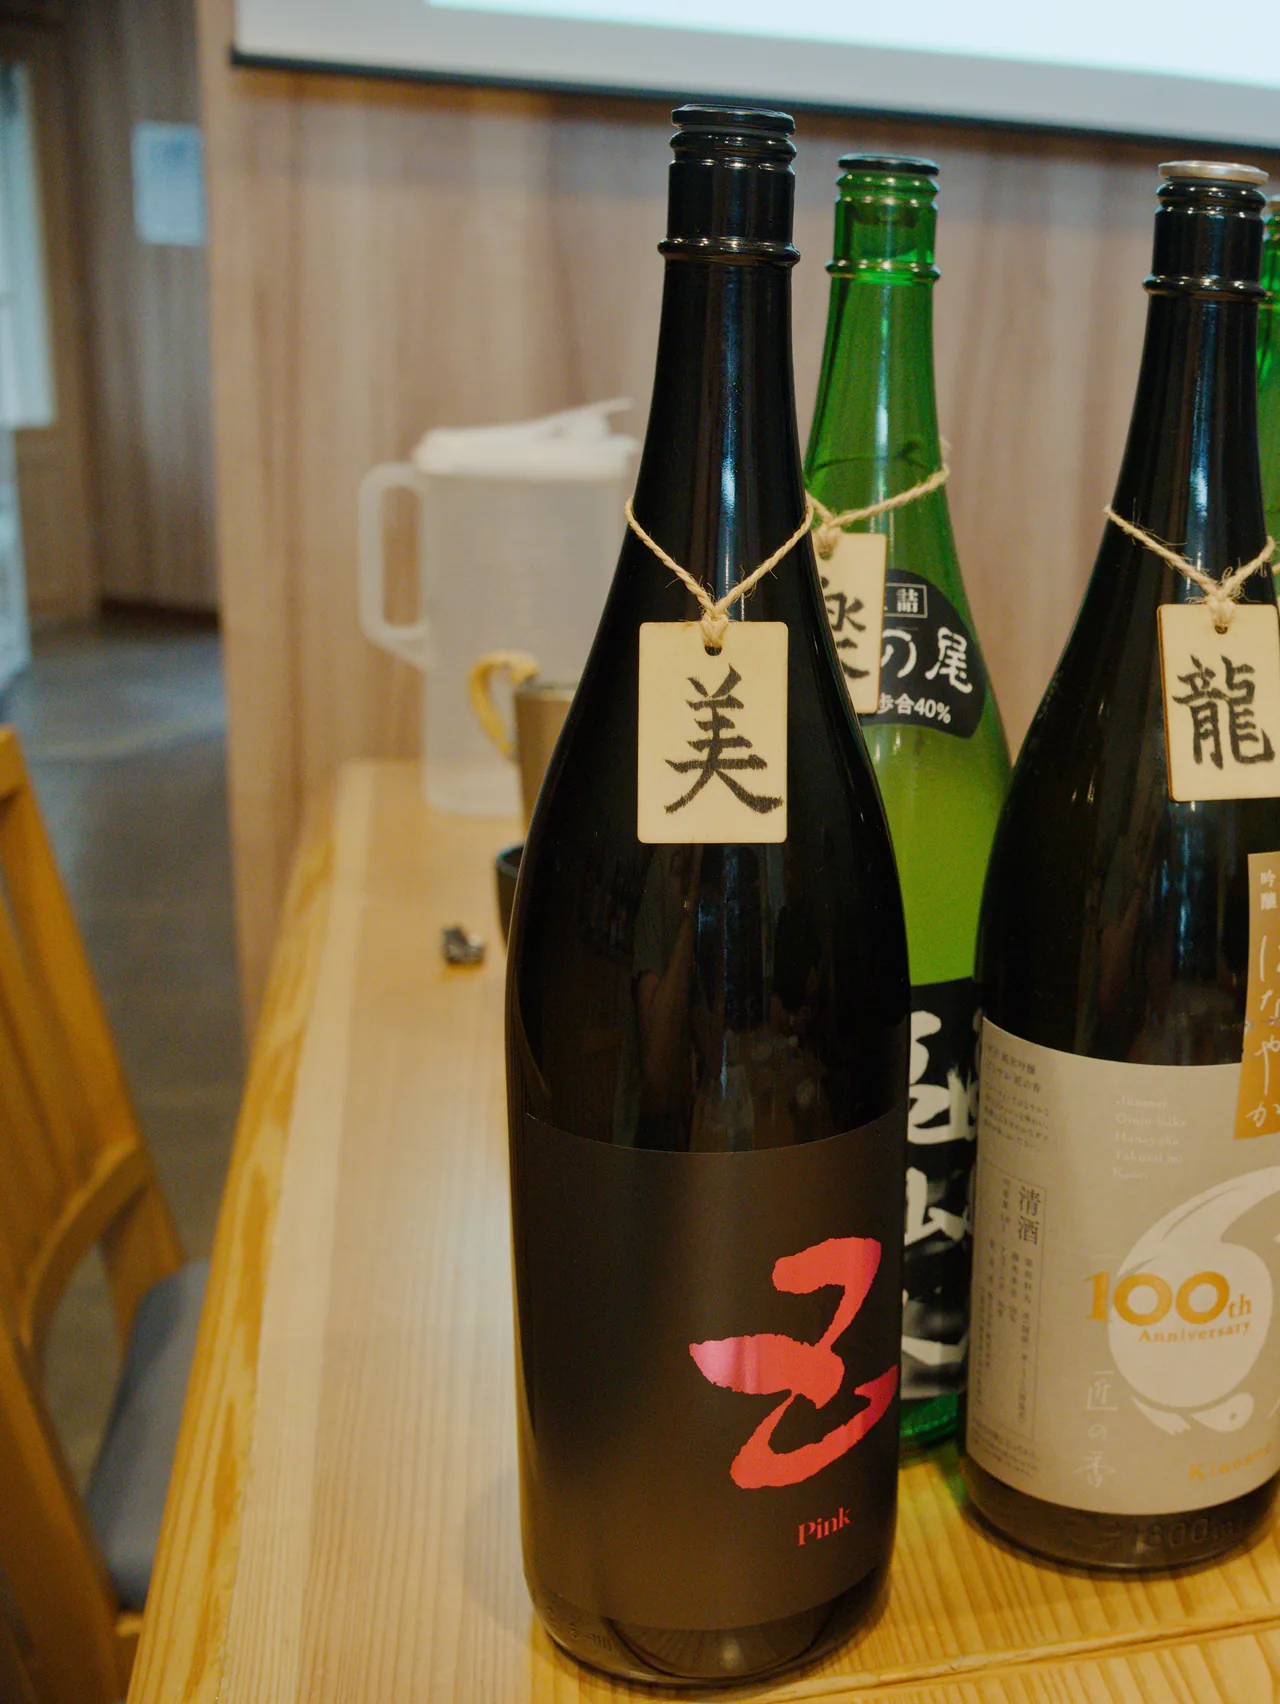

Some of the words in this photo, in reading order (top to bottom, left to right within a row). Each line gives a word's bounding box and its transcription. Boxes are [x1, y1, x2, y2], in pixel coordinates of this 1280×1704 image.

[664, 662, 784, 815] 美
[1171, 653, 1276, 771] 龍
[1018, 1184, 1042, 1246] 清酒
[1082, 1270, 1253, 1327] 100th
[1137, 1319, 1251, 1344] Anniversary
[797, 1506, 851, 1547] Pink
